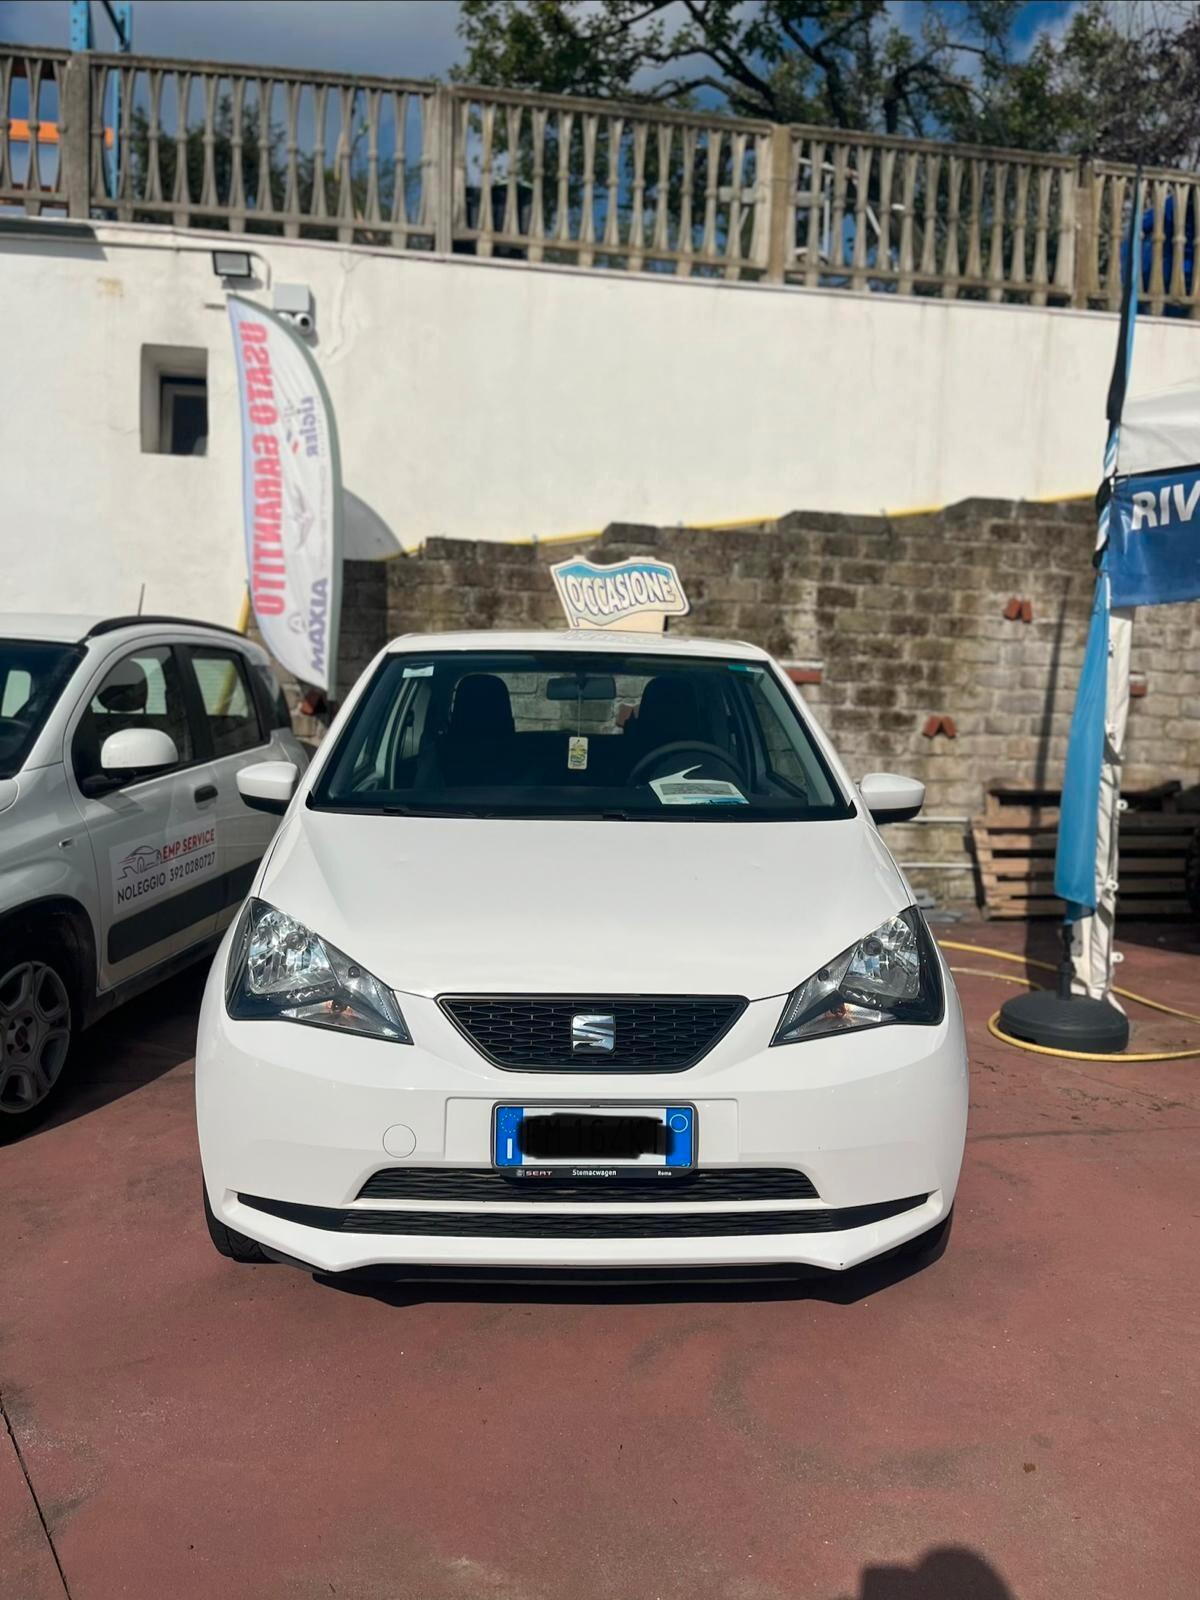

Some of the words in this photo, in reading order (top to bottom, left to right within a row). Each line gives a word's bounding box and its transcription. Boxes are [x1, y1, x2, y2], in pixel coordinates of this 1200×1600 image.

[565, 570, 676, 616] OCCASIONE
[183, 828, 215, 852] SERVICE
[117, 872, 166, 904] NOLEGGIO
[572, 1168, 617, 1177] Stemacwagen
